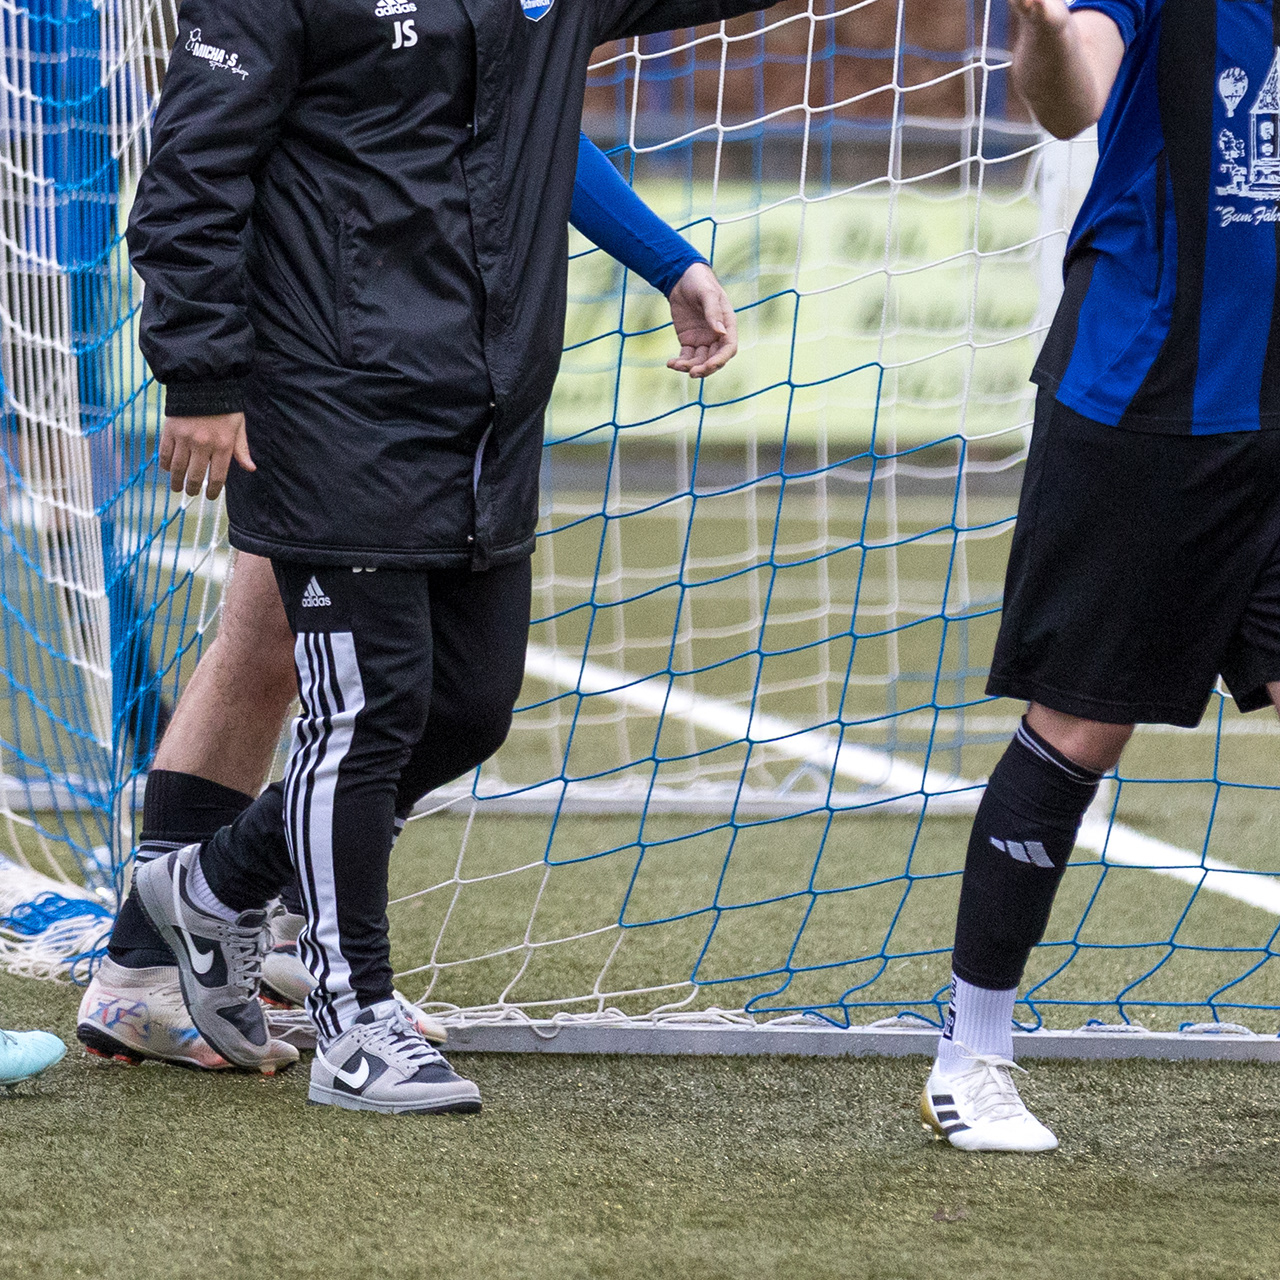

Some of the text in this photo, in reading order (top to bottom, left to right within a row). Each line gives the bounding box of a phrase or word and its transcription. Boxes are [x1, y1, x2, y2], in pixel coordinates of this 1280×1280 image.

[374, 2, 418, 18] adidas
[392, 18, 419, 50] JS
[301, 595, 332, 608] adidas
